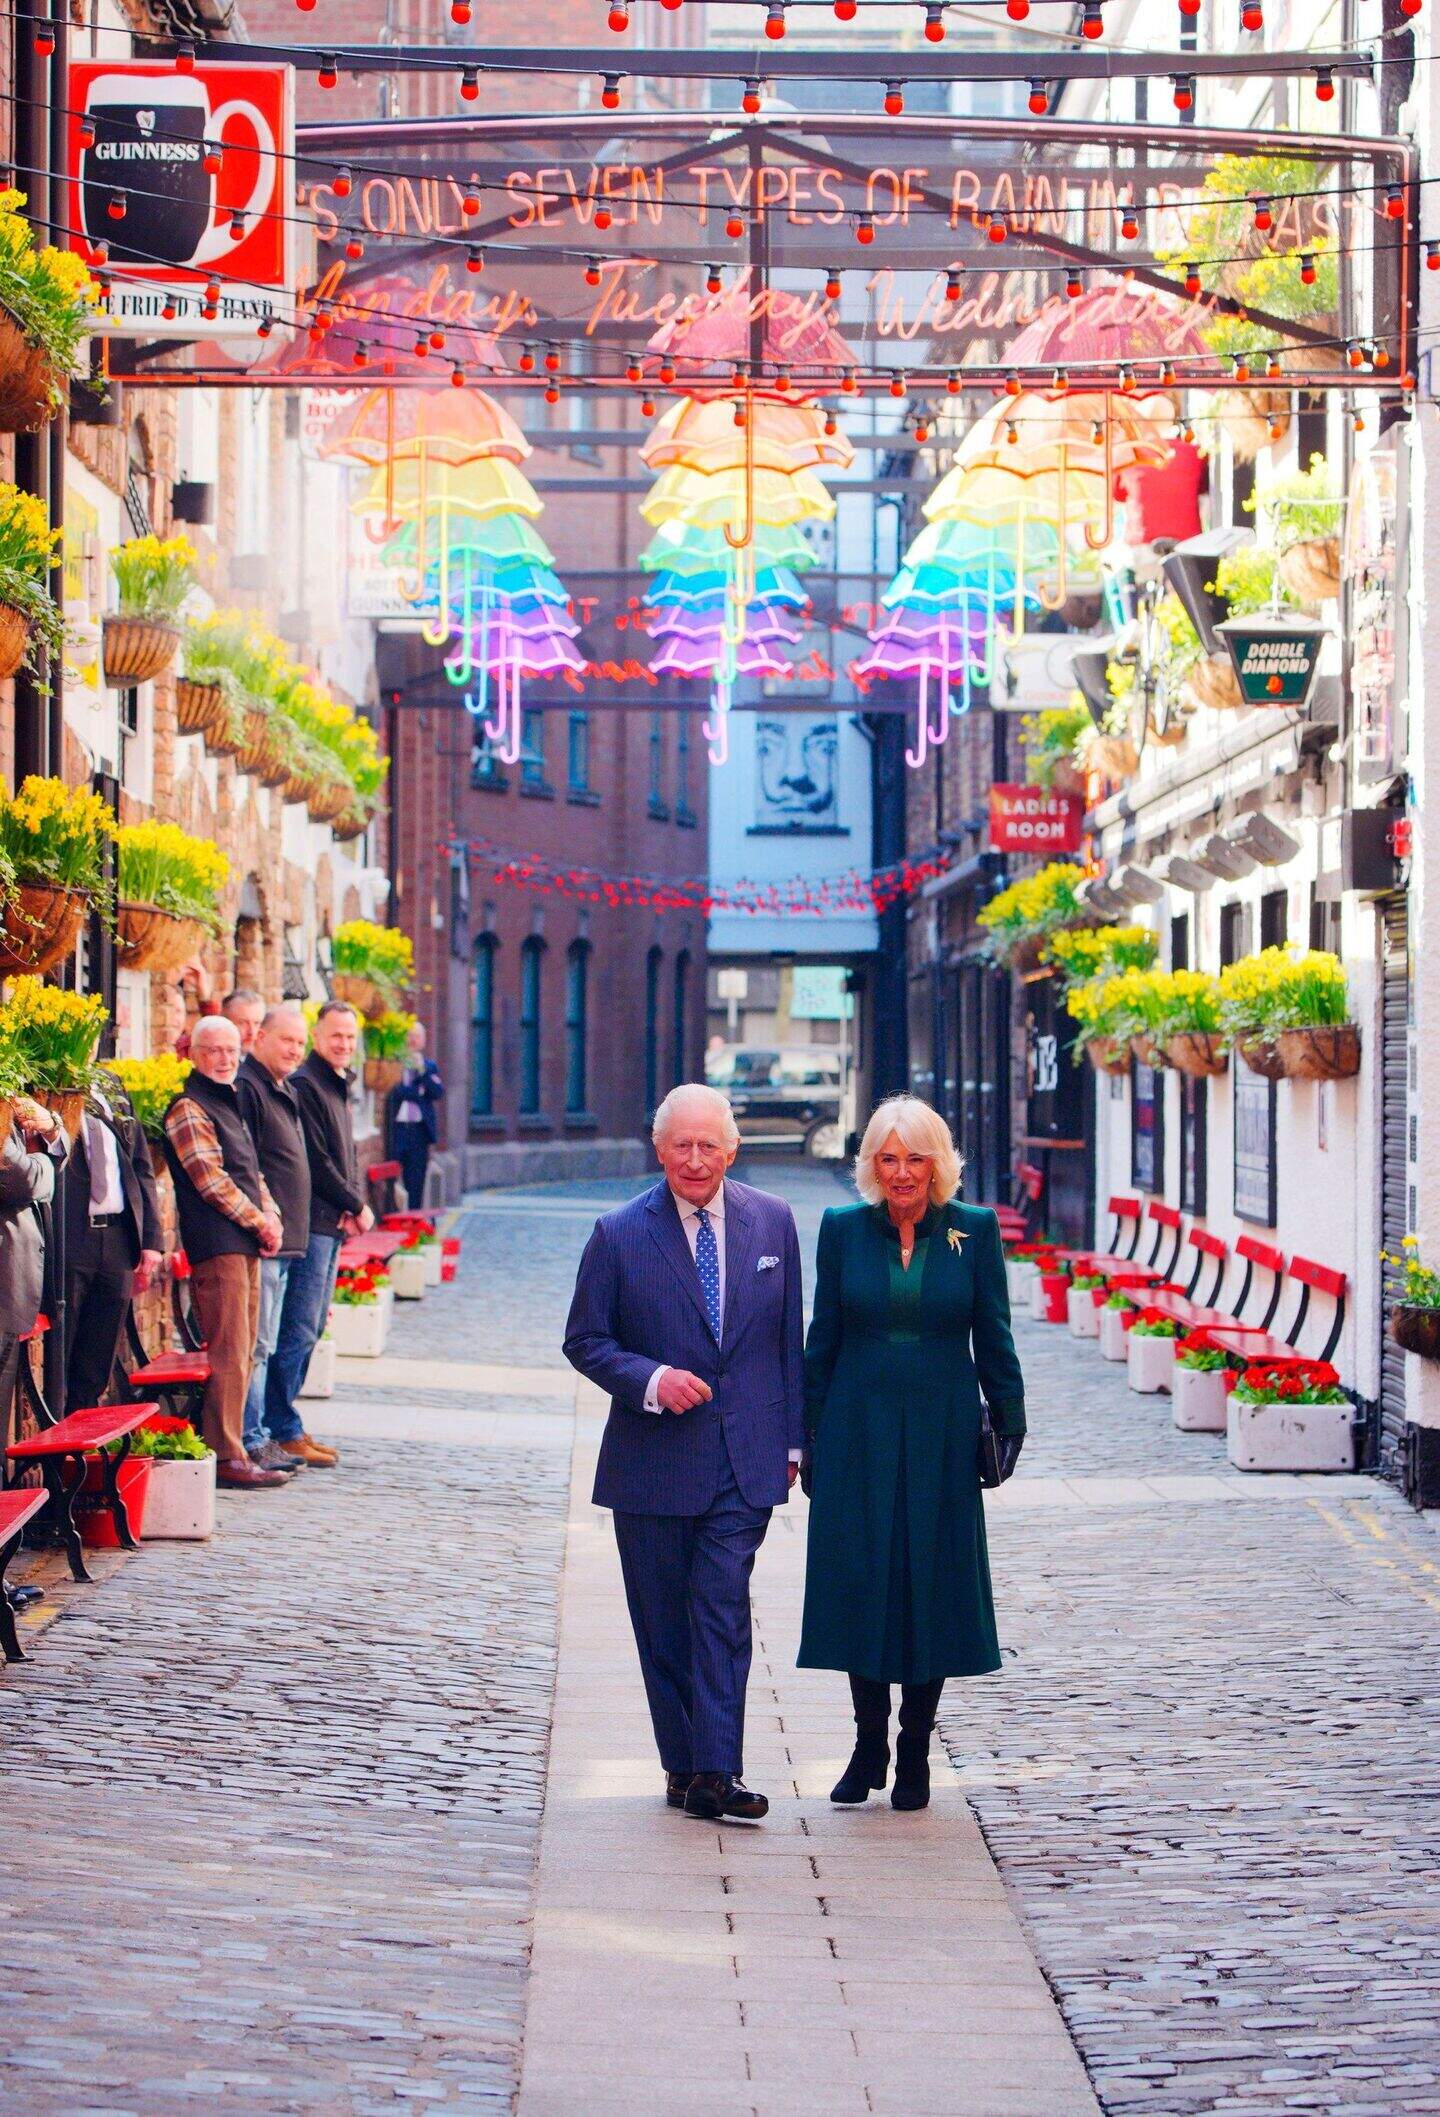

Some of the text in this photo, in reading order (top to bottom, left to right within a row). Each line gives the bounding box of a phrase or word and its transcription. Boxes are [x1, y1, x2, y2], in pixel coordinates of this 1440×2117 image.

[95, 142, 200, 161] GUINNESS
[362, 172, 480, 237] ONLY
[507, 166, 663, 228] SEVEN
[688, 166, 846, 226] TYPES
[865, 167, 929, 226] OF
[952, 169, 1069, 234] RAIN
[121, 294, 189, 317] FRIED
[222, 296, 273, 319] HAND
[1247, 642, 1305, 658] DOUBLE
[1241, 658, 1310, 674] DIAMOND
[1002, 798, 1069, 816] LADIES
[1006, 821, 1066, 839] ROOM
